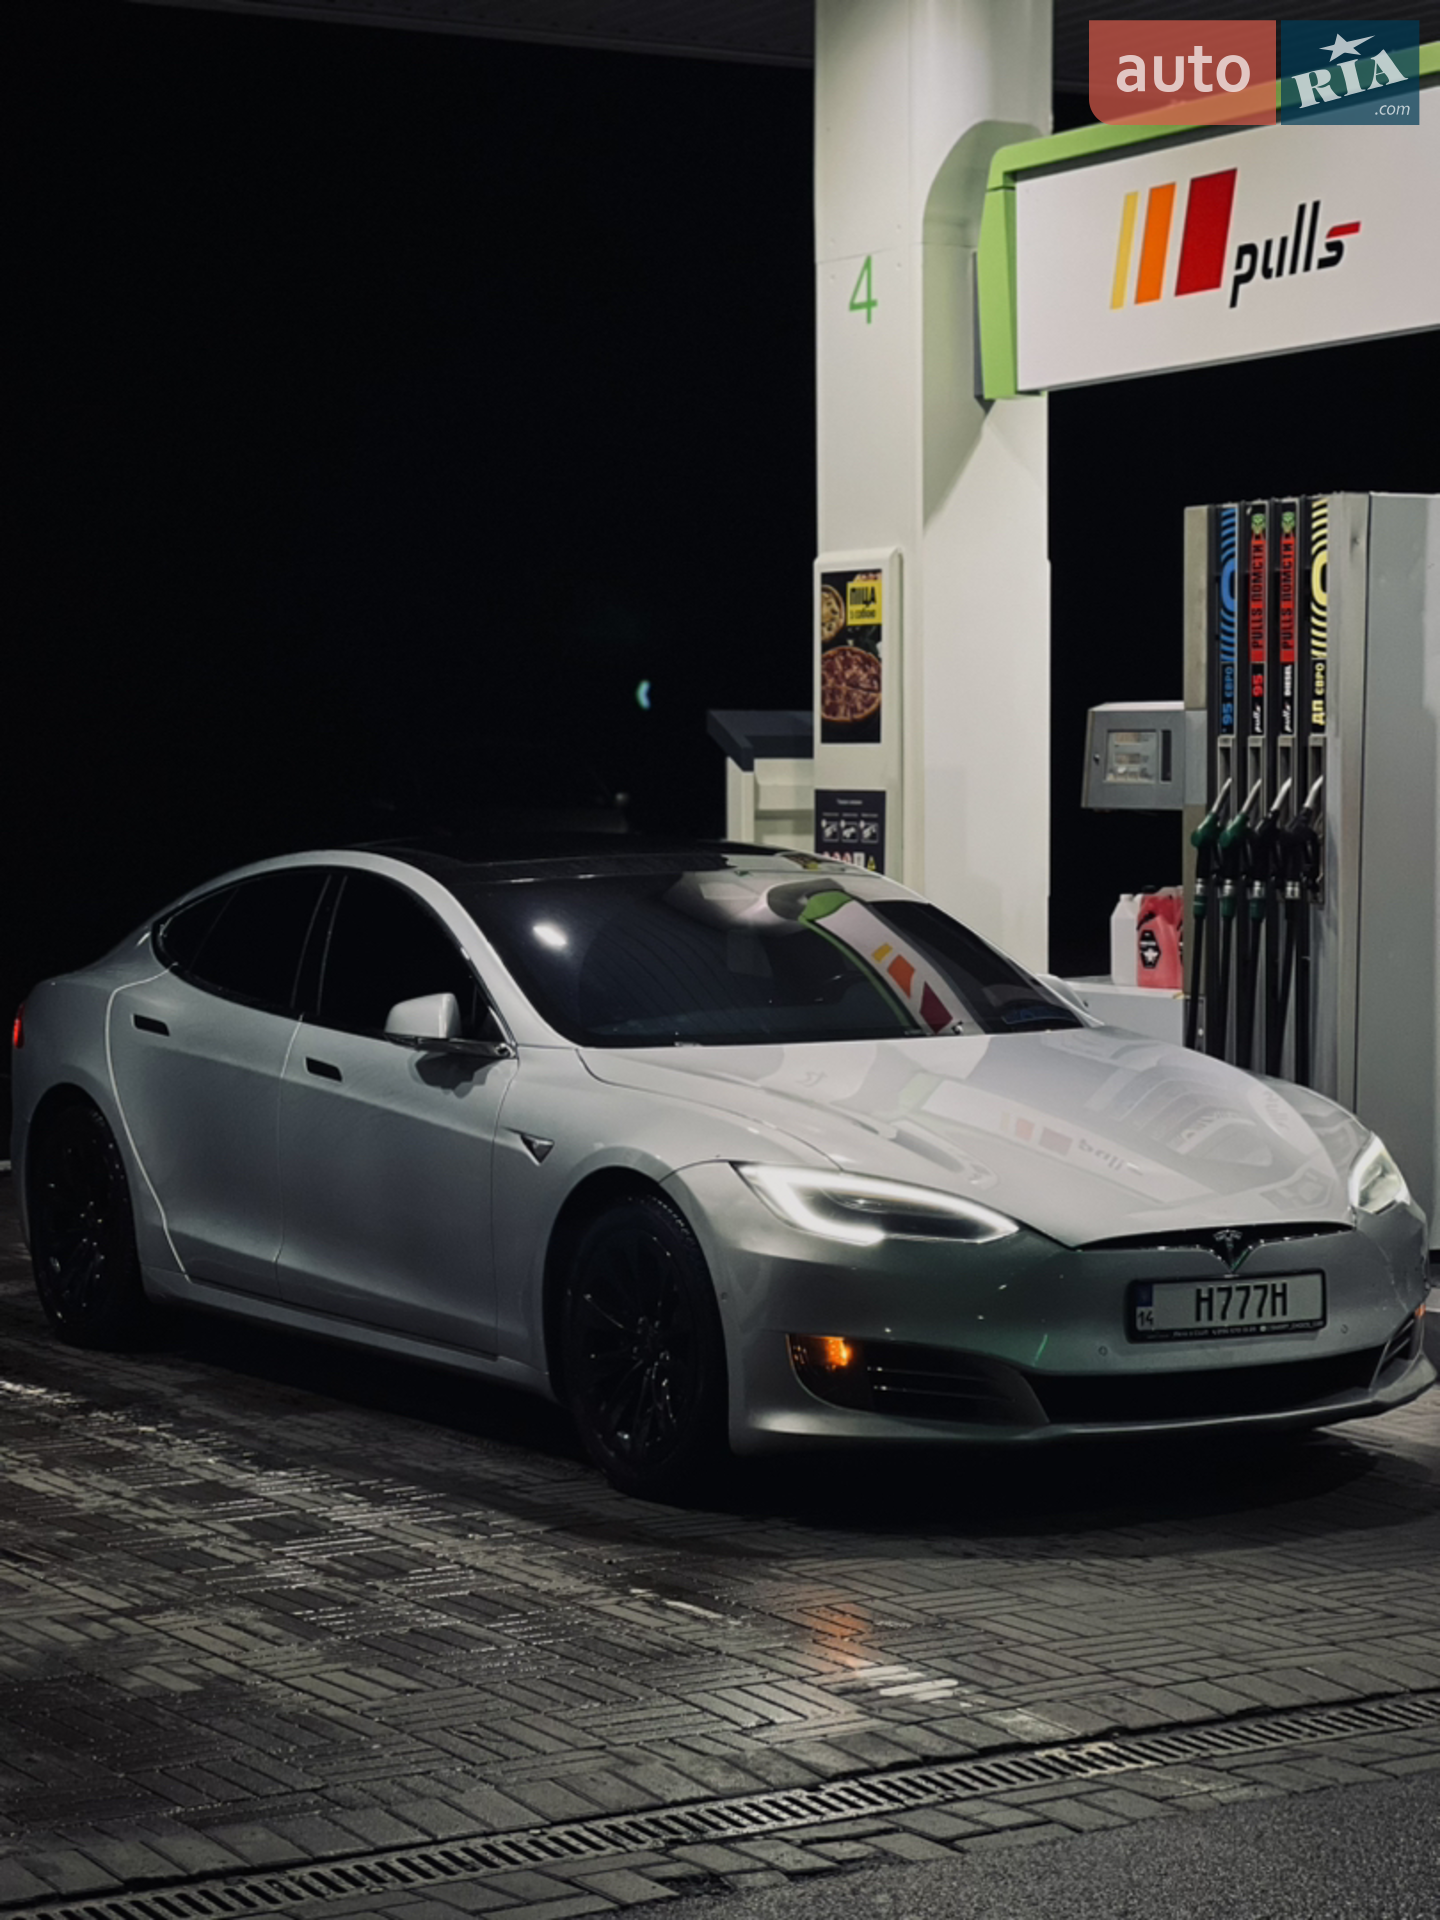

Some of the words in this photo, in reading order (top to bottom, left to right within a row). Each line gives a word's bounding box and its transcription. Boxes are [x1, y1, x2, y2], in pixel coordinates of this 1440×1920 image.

[1229, 200, 1361, 308] pulls
[848, 255, 878, 324] 4
[1252, 608, 1264, 650] PULLS
[1282, 607, 1294, 650] PULLS
[1251, 673, 1264, 697] 95
[1284, 664, 1293, 697] DIESEL
[1315, 662, 1325, 696] ЄВРО
[1312, 700, 1326, 725] ДП
[1137, 1310, 1153, 1326] 14
[1195, 1282, 1288, 1322] H777H
